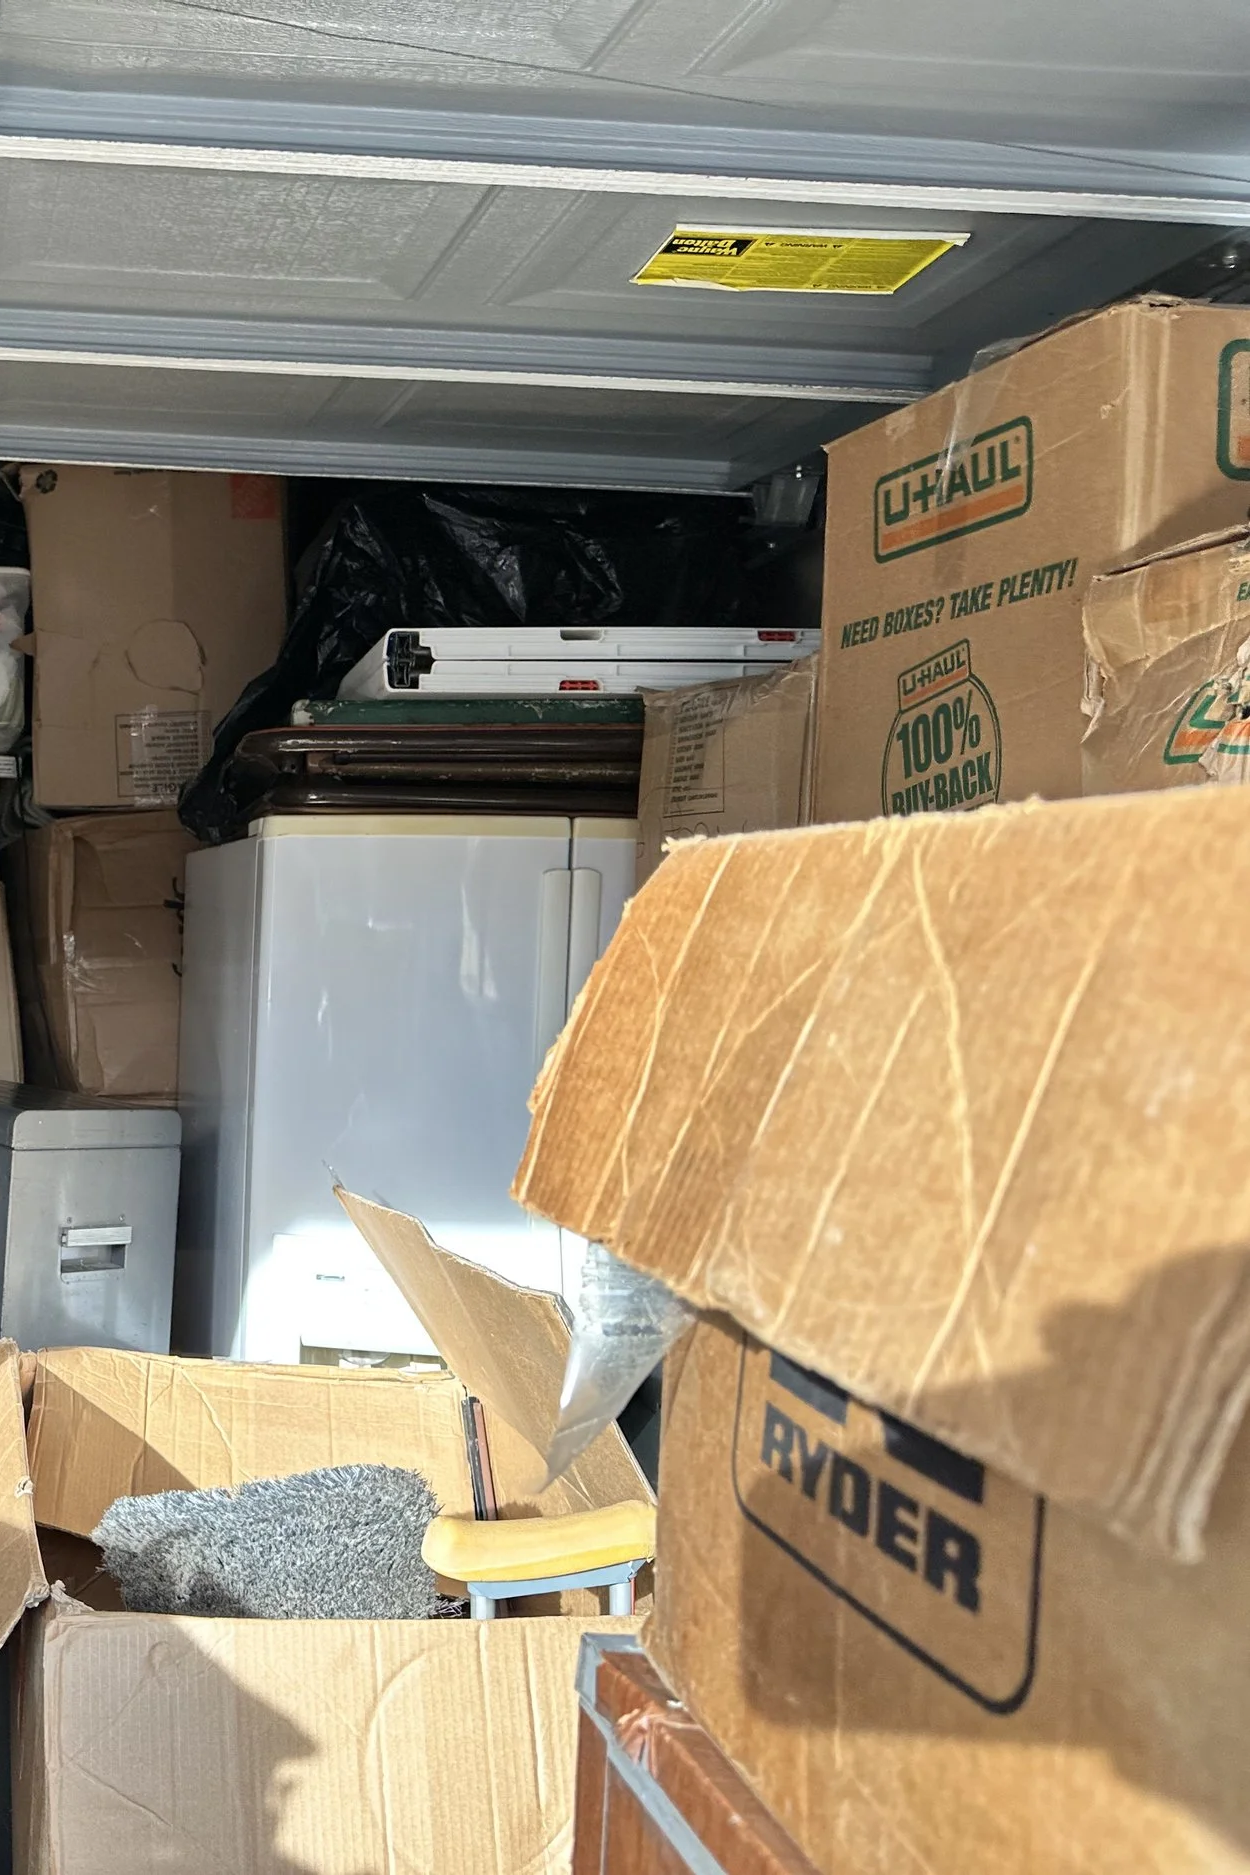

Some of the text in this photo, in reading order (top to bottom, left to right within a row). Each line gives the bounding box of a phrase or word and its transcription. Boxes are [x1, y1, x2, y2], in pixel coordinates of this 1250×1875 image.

[673, 238, 737, 248] Dalton
[676, 245, 739, 256] Wayne
[841, 557, 1079, 648] NEED BOXES? TAKE PLENTY!
[896, 689, 981, 780] 100%
[760, 1399, 981, 1614] RYDER
